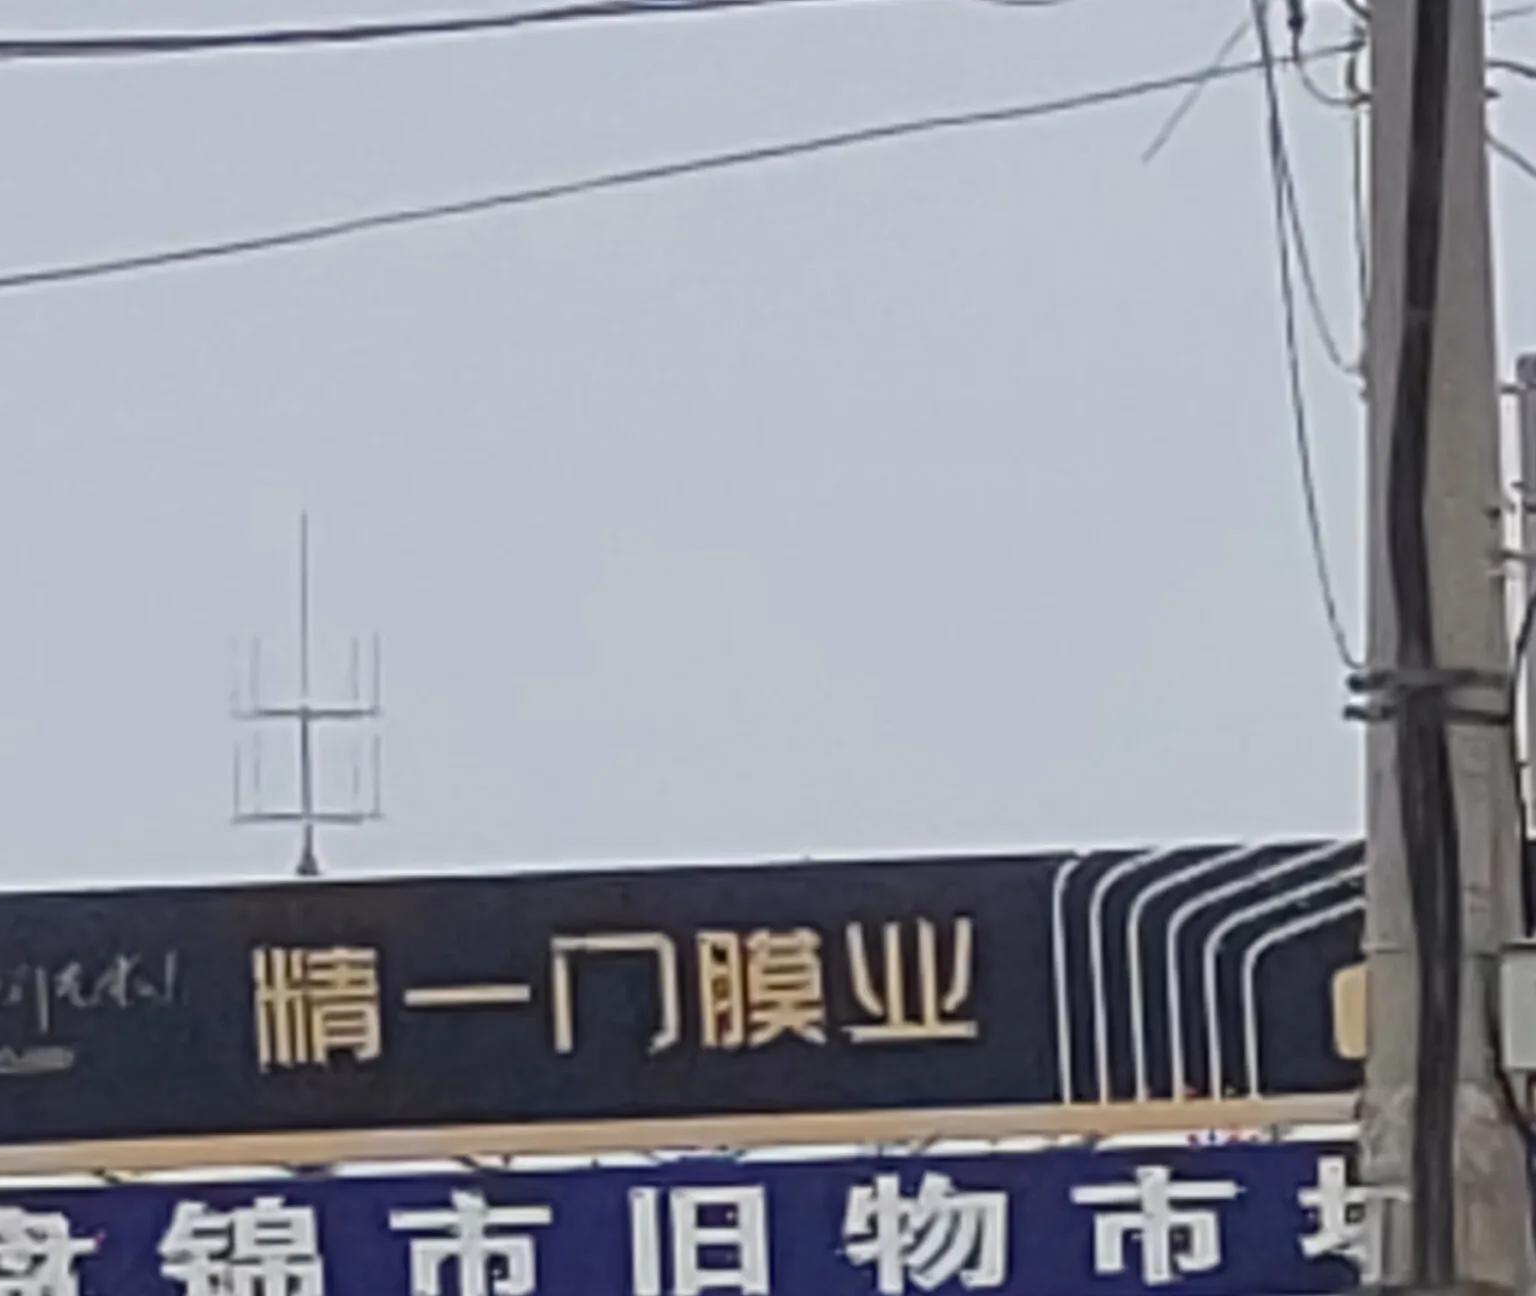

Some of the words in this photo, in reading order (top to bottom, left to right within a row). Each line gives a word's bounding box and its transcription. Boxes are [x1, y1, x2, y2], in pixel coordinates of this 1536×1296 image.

[252, 915, 980, 1072] 精一门膜业
